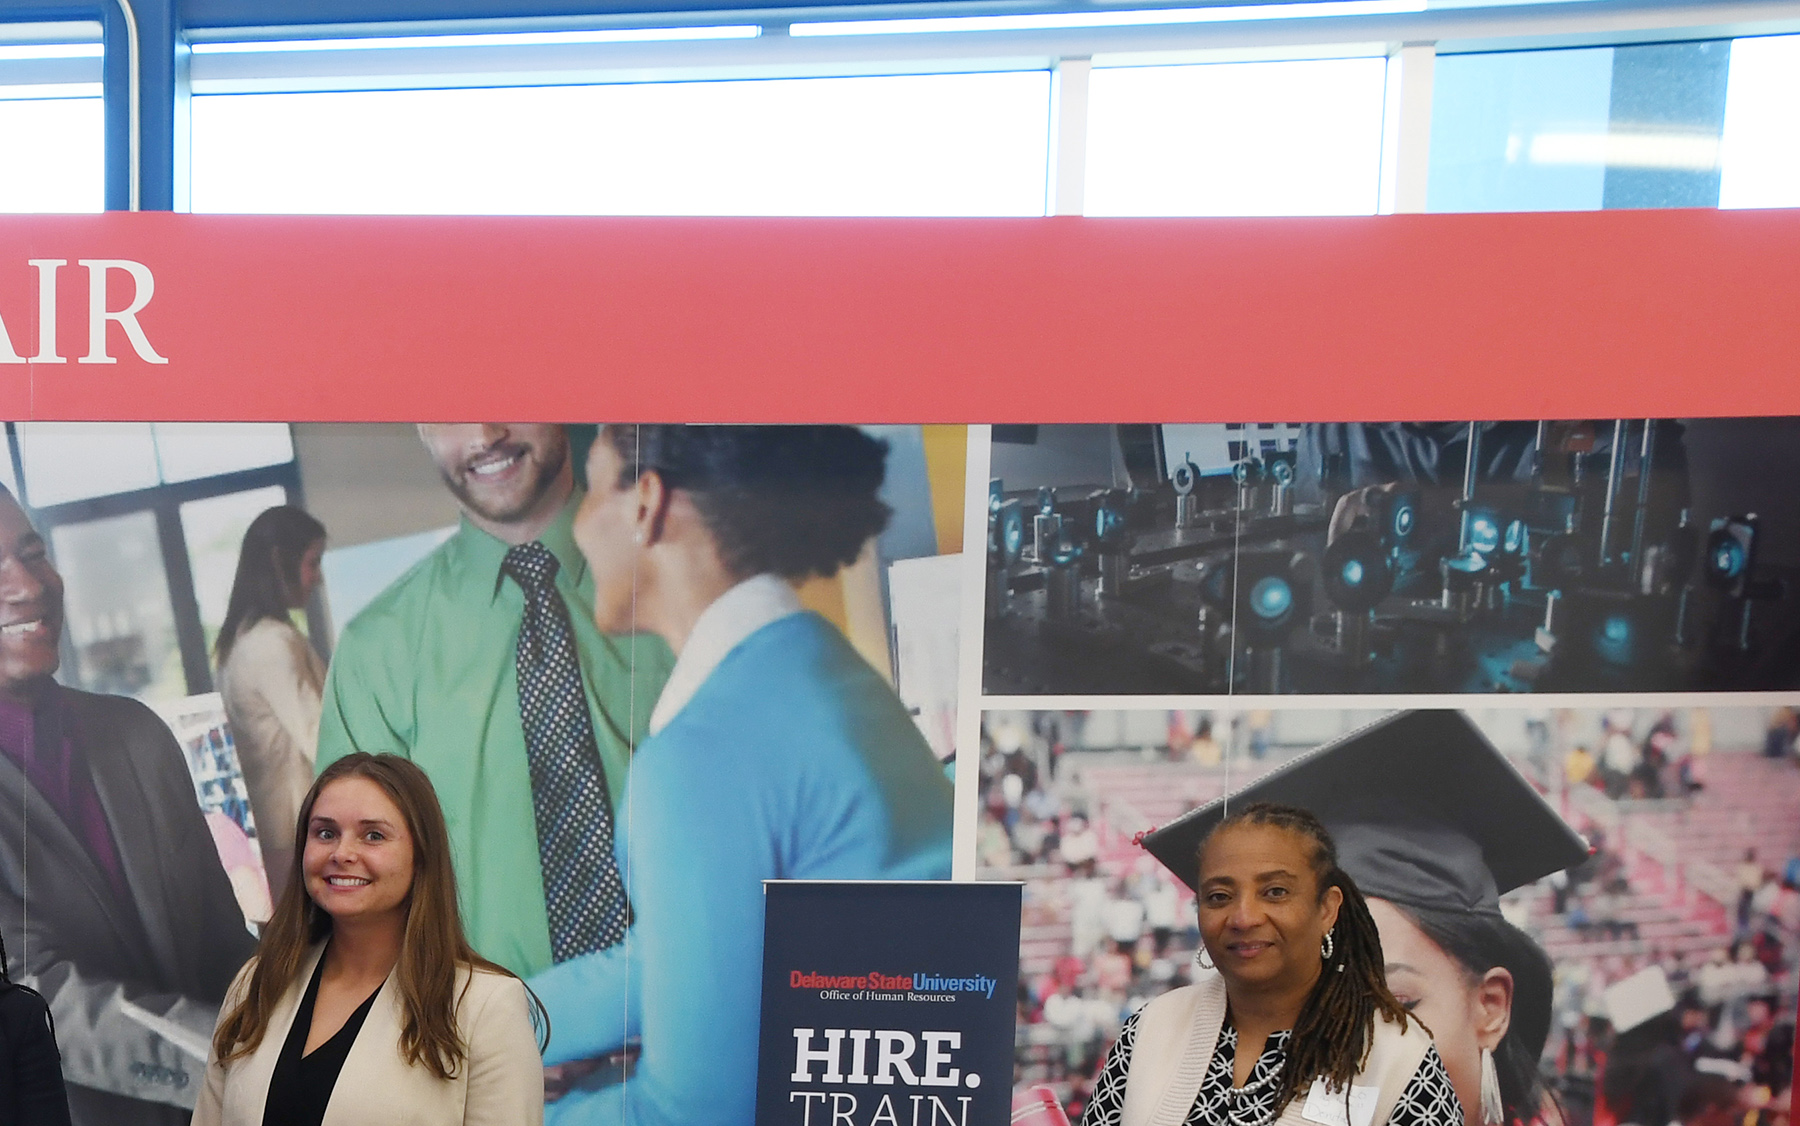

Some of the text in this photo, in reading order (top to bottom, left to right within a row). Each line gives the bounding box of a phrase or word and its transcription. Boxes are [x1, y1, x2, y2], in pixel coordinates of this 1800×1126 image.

[790, 970, 997, 999] Delaware State University
[820, 990, 956, 1002] Office of Human Resources
[791, 1028, 981, 1089] HIRE.
